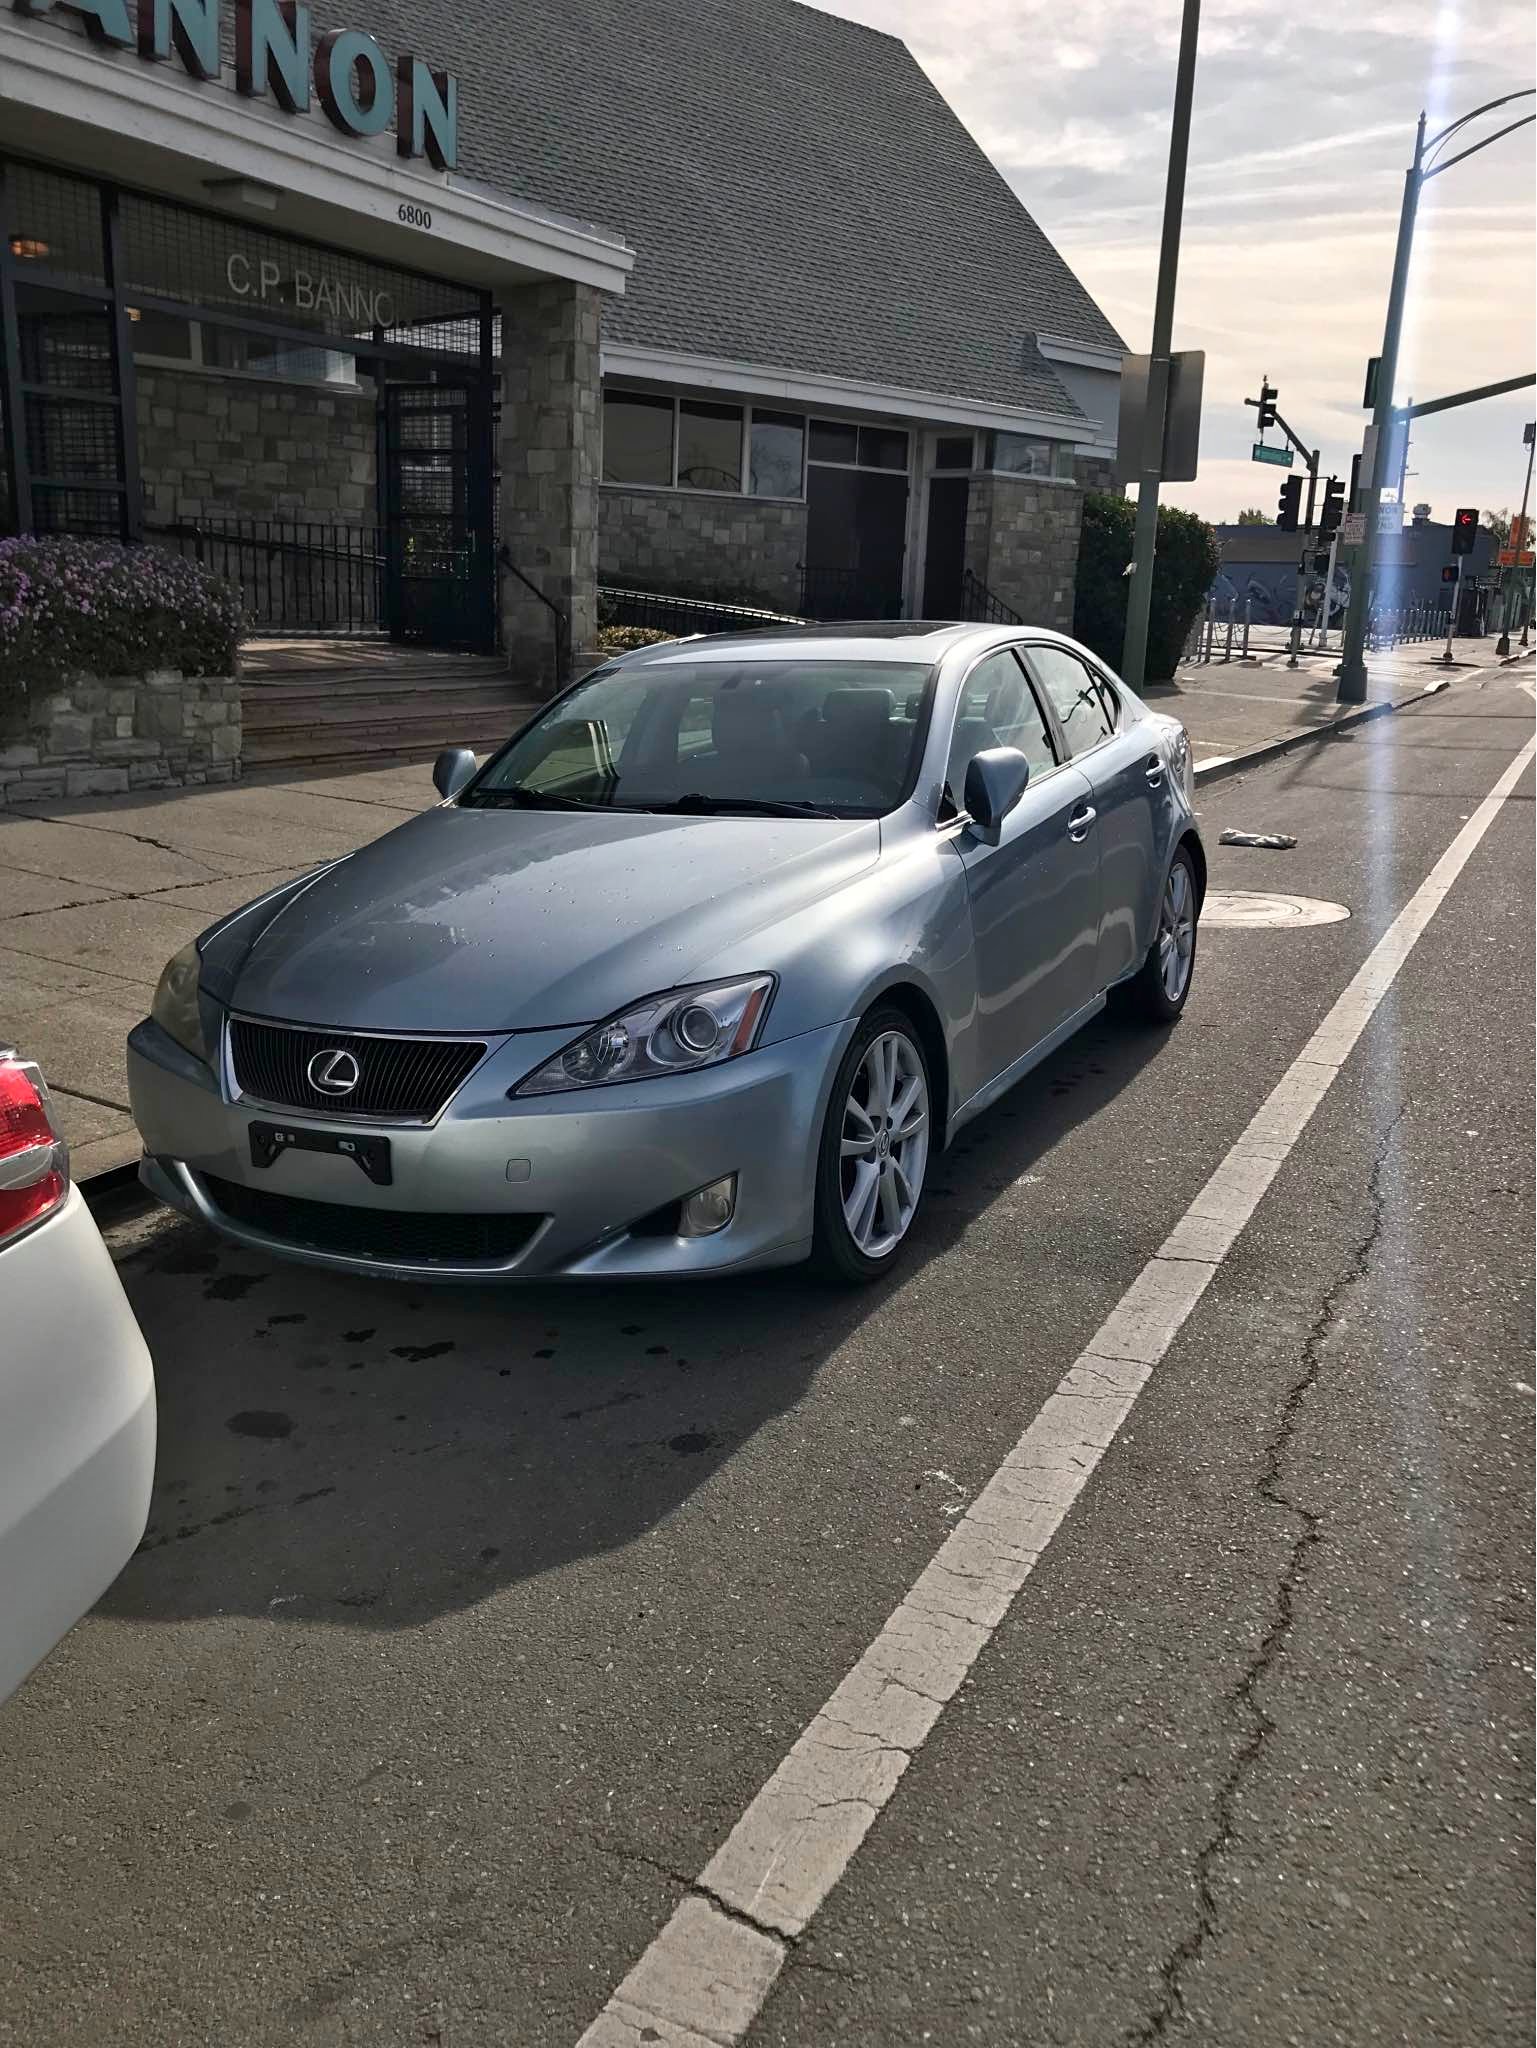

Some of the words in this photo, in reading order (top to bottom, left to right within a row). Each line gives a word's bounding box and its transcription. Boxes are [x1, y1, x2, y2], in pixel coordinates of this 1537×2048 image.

[398, 204, 431, 229] 6800
[226, 253, 285, 304] C.P.
[295, 269, 401, 328] BANNO
